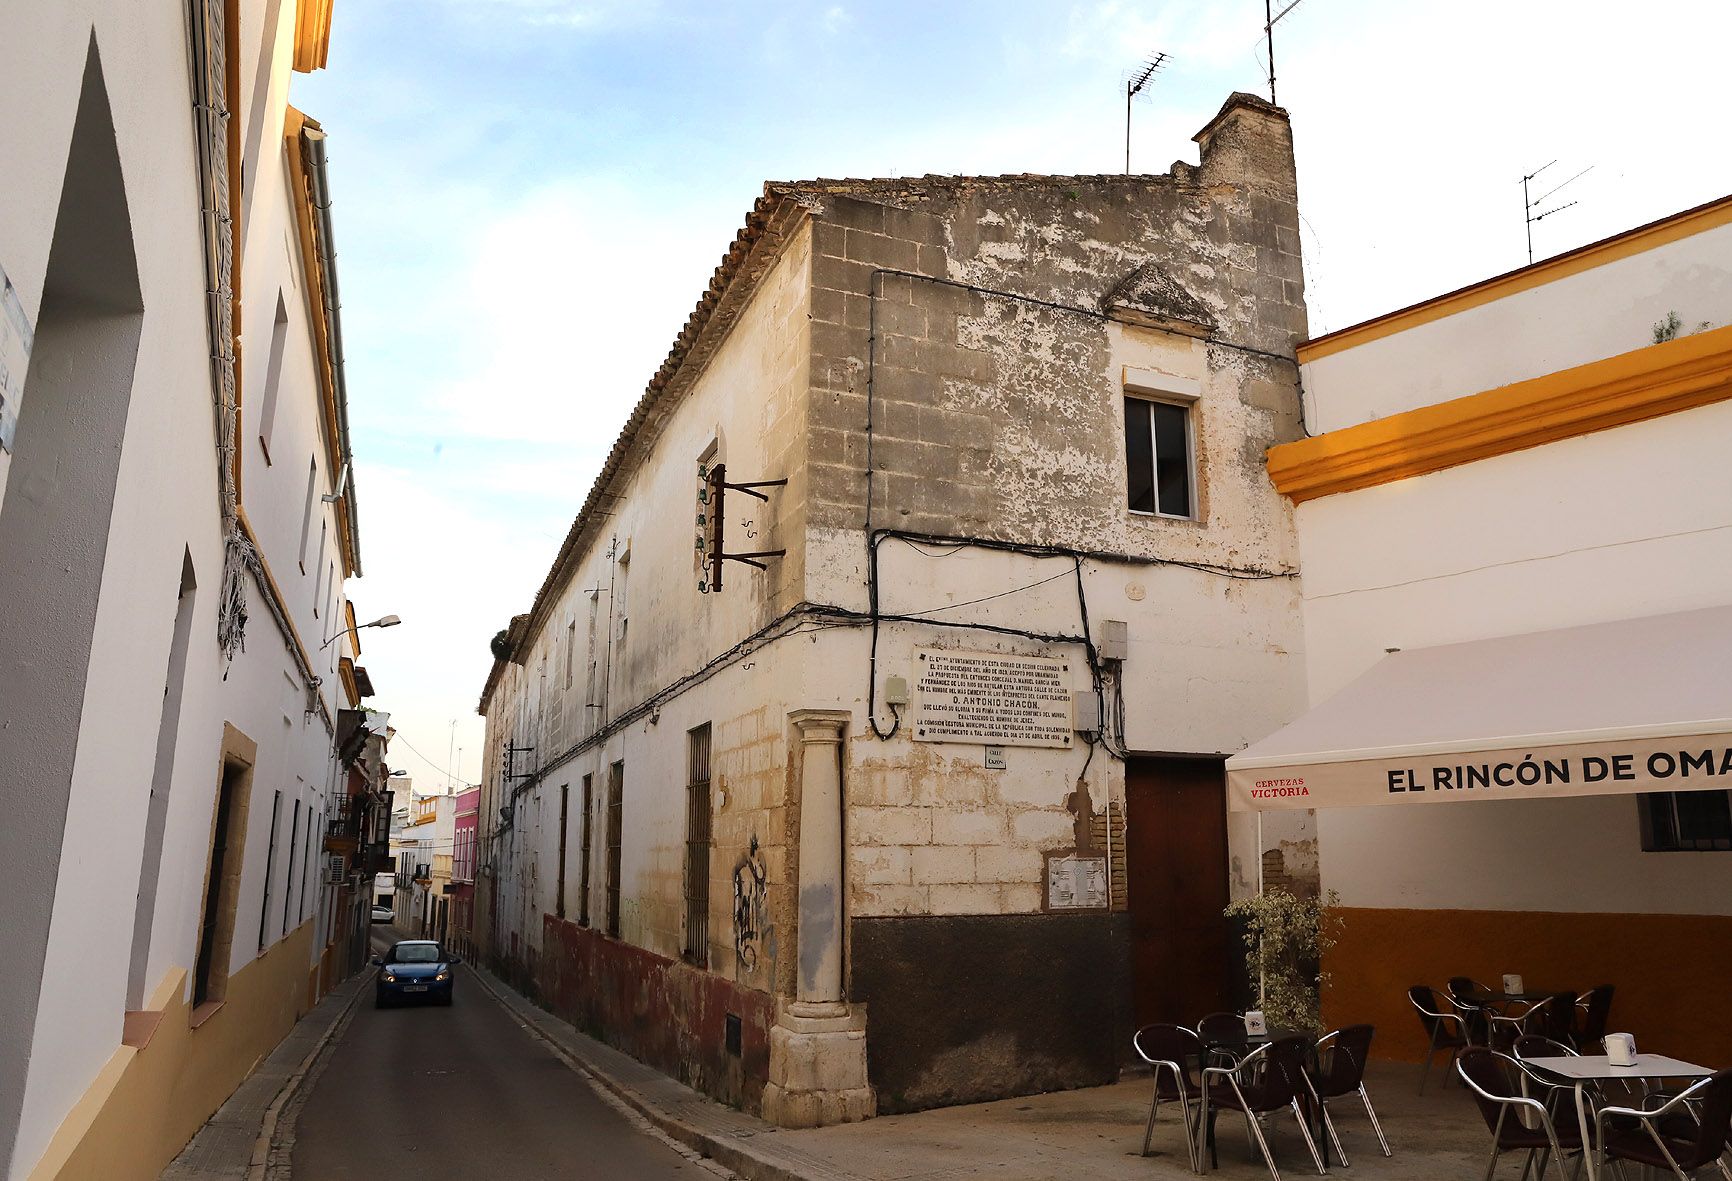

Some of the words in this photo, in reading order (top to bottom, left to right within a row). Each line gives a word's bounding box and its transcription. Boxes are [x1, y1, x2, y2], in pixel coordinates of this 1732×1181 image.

[953, 696, 960, 704] D.
[963, 697, 1000, 706] ANTONIO
[1388, 769, 1425, 793] EL
[1433, 754, 1570, 790] RINCÓN
[1582, 755, 1636, 782] DE
[1255, 778, 1304, 788] CERVEZAS
[1251, 786, 1309, 798] VICTORIA
